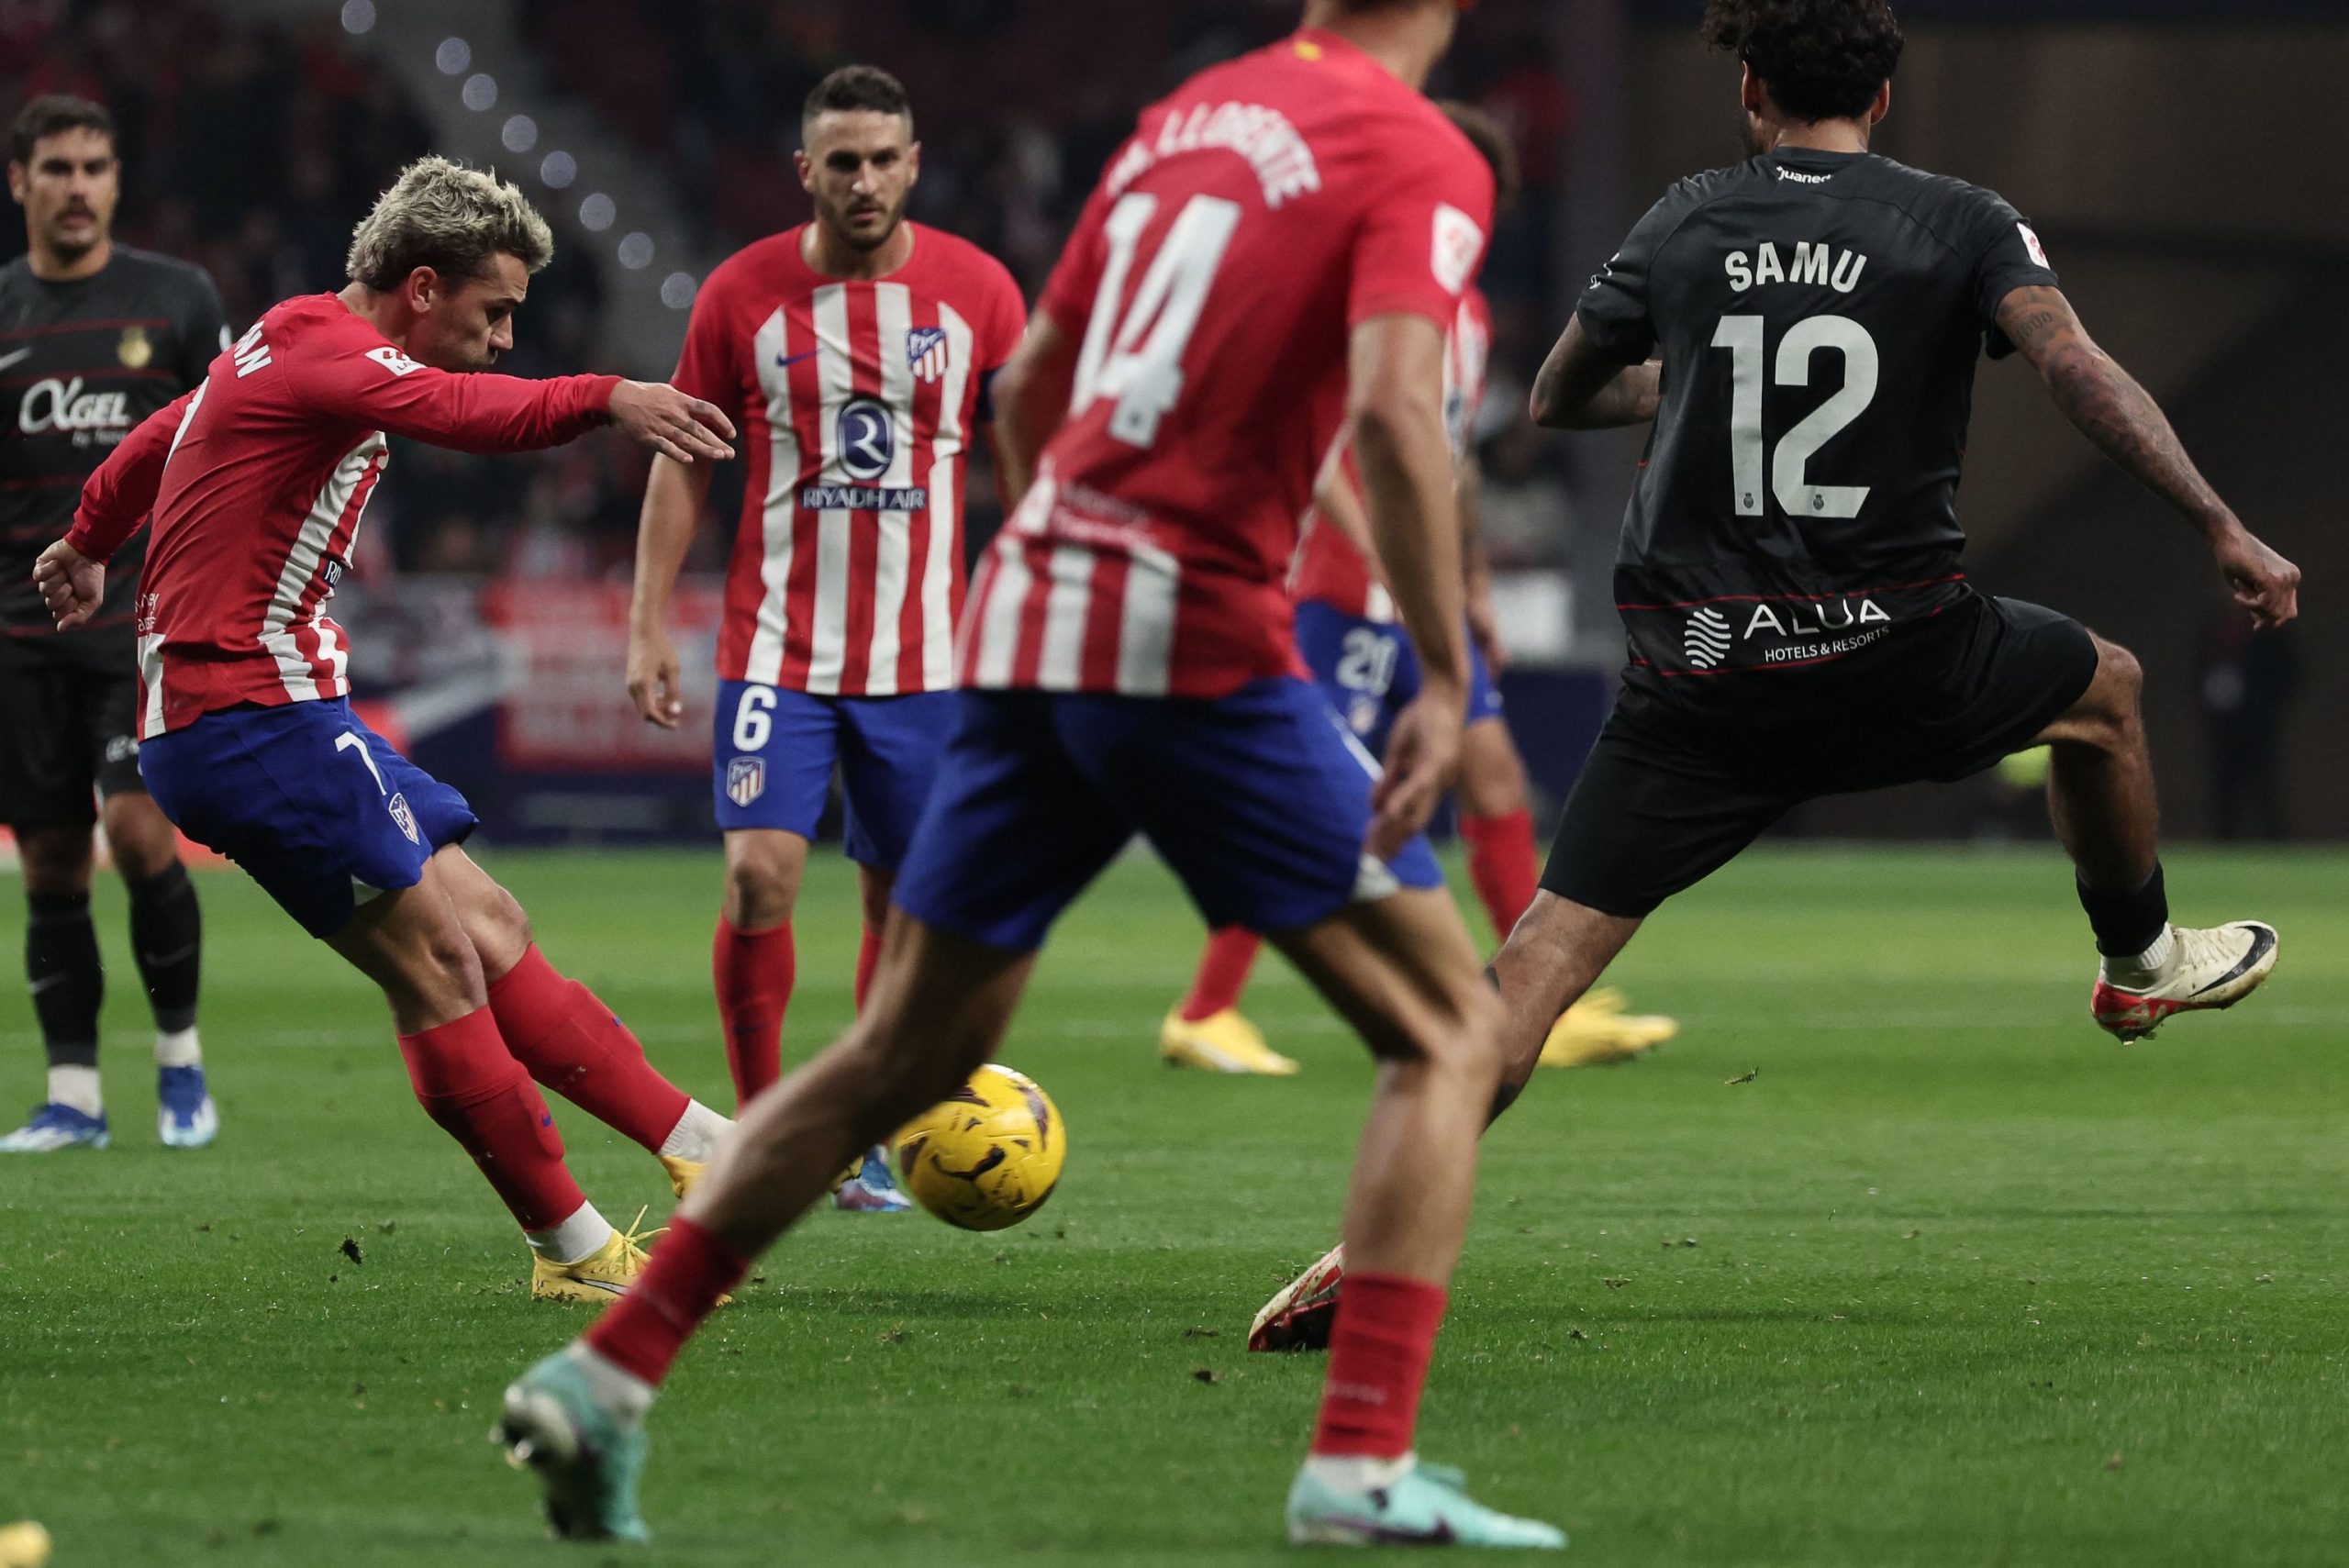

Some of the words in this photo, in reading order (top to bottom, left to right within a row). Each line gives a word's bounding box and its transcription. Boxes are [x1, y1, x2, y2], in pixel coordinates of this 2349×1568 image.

[1724, 241, 1867, 293] SAMU
[1069, 191, 1243, 450] 14
[1710, 315, 1879, 519] 12
[803, 486, 886, 509] RIYADH
[888, 488, 926, 510] AIR
[1743, 598, 1892, 640] ALUA
[1765, 642, 1818, 662] HOTELS
[1820, 642, 1831, 655] &
[1832, 626, 1890, 653] RESORTS
[732, 684, 778, 752] 6
[334, 730, 387, 796] 7
